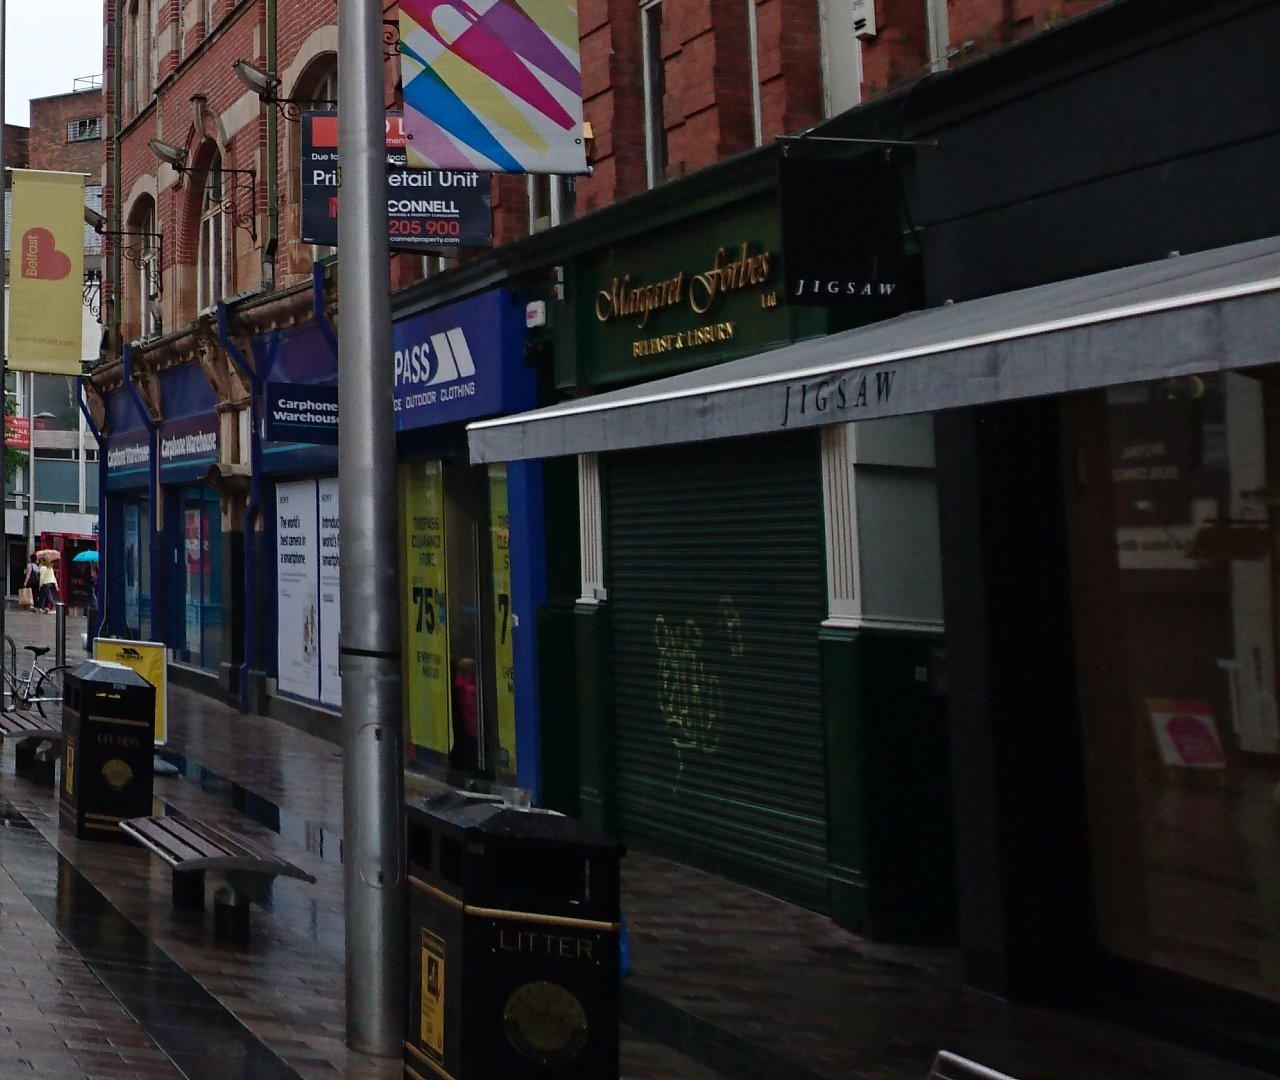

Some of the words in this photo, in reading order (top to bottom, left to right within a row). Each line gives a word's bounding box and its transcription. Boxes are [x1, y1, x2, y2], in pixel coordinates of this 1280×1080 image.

[311, 153, 329, 161] Due
[313, 170, 336, 186] Pri
[387, 171, 432, 187] etail
[440, 172, 478, 187] Unit
[387, 200, 459, 214] CONNELL
[389, 220, 421, 235] 205
[425, 221, 460, 236] 900
[25, 235, 38, 276] Belfast
[690, 241, 771, 313] Forbes
[795, 279, 897, 296] JIGSAW
[394, 343, 430, 387] PASS
[277, 398, 339, 413] Carphone
[406, 391, 437, 409] OUTDOOR
[440, 383, 475, 402] CLOTHING
[782, 370, 897, 427] JIGSAW
[161, 435, 185, 460] Carphone
[185, 430, 216, 454] Warehouse
[499, 928, 594, 959] LITTER
